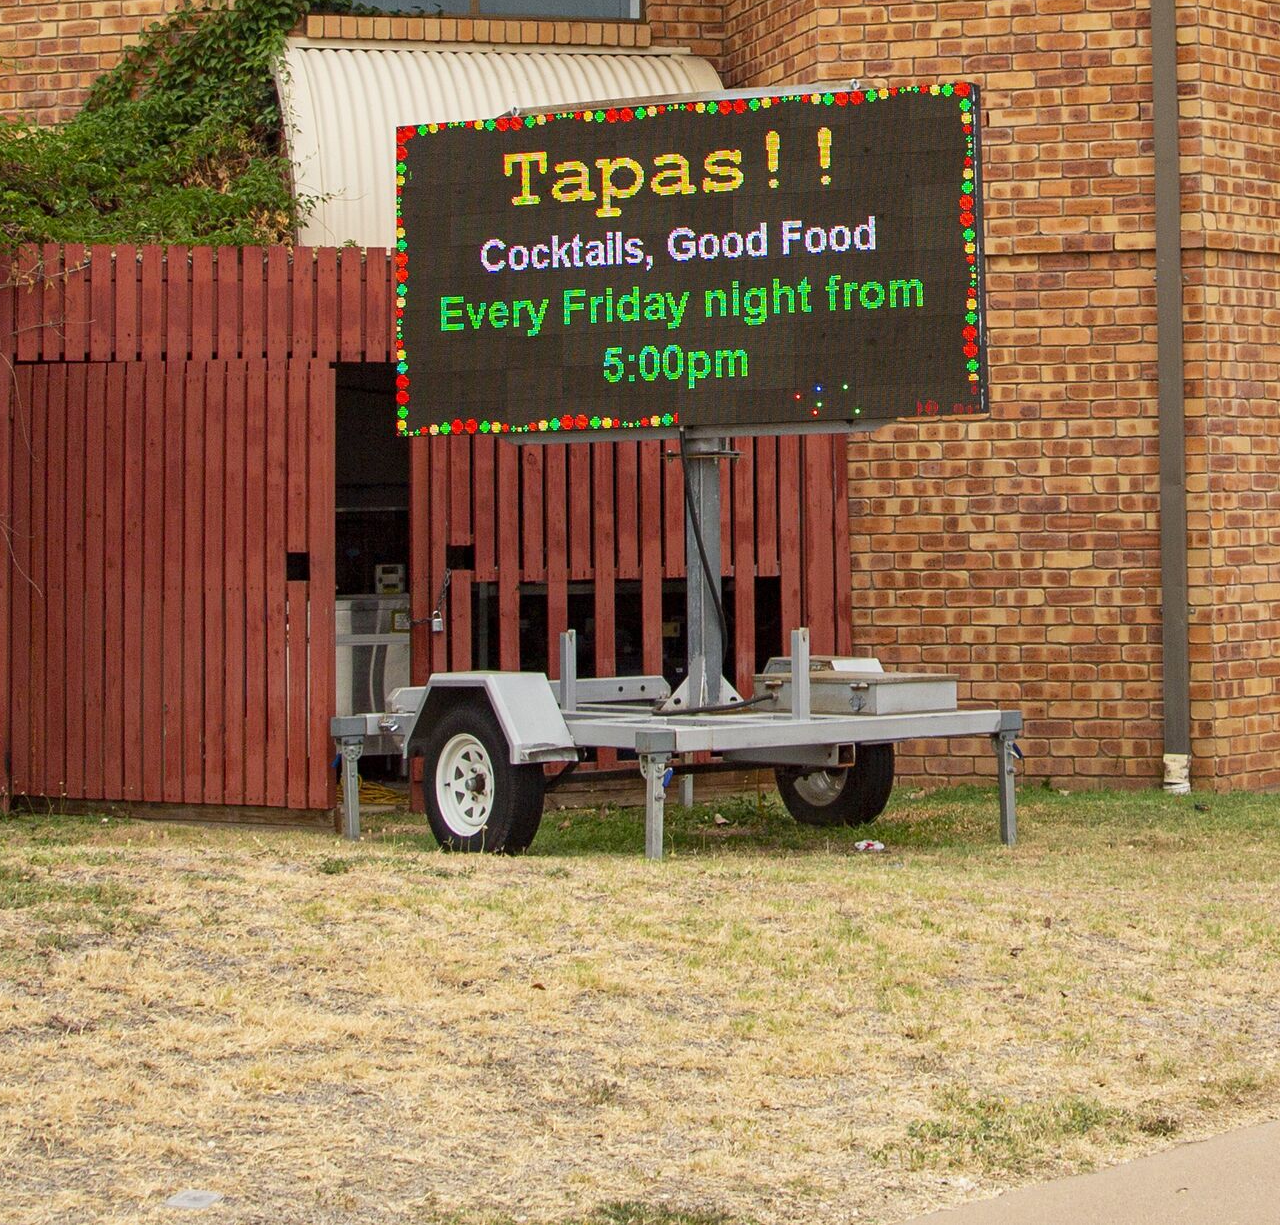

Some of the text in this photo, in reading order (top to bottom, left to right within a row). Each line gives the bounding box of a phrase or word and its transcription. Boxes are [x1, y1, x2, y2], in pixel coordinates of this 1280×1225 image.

[480, 215, 877, 272] Cocktails, Good Food
[440, 275, 924, 336] Every Friday night from
[603, 345, 748, 389] 5:00pm
